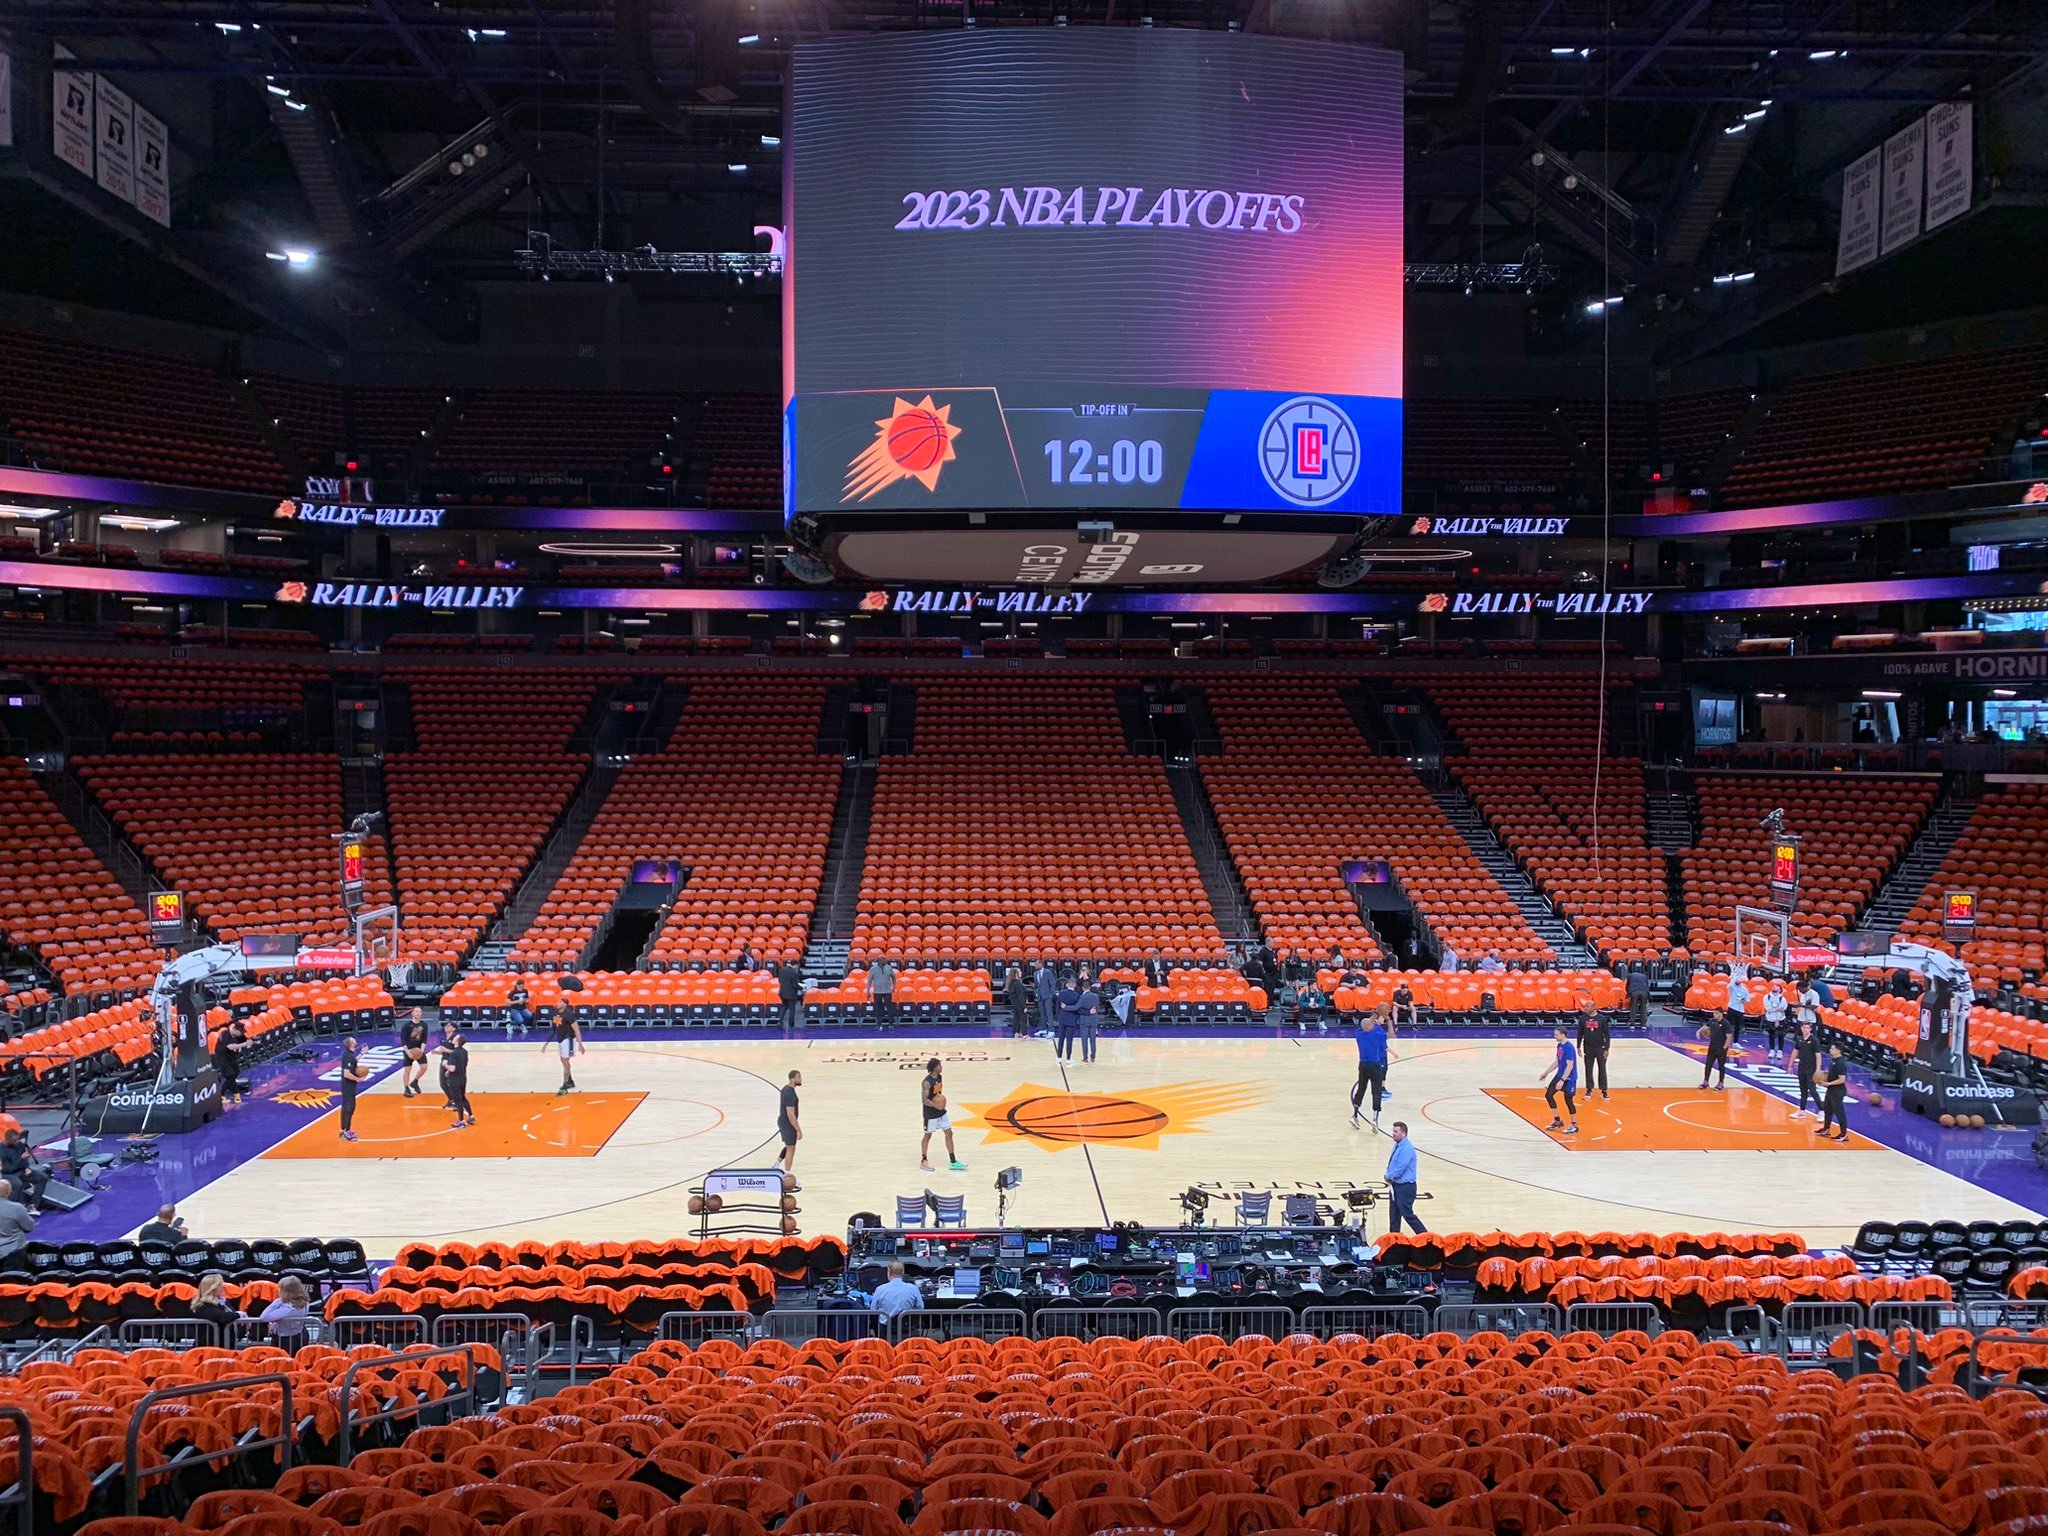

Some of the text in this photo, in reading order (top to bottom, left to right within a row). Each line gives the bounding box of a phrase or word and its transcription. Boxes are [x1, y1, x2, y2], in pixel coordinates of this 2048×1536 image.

[1937, 116, 1961, 142] SUNS
[1887, 127, 1922, 161] PHOENIX
[1892, 147, 1914, 173] SUNS
[1846, 154, 1879, 185] PHOENIX
[1850, 174, 1871, 199] SUNS
[894, 186, 1305, 234] 2023 NBA PLAYOFFS
[1080, 404, 1128, 415] TIP-OFF IN
[1044, 439, 1163, 485] 12:00
[1463, 484, 1491, 493] ASSIST
[297, 502, 447, 527] RALLY THE VALLEY
[1431, 518, 1494, 534] RALLY
[1501, 518, 1570, 534] VALLEY
[311, 583, 524, 608] RALLY THE VALLEY
[893, 591, 1092, 612] RALLY THE VALLEY
[1452, 593, 1653, 613] RALLY THE VALLEY
[1884, 662, 1949, 675] 100% AGAVE
[1701, 727, 1731, 740] HORNITOS
[1777, 846, 1795, 860] 12:00
[345, 859, 359, 881] 24
[1777, 859, 1792, 879] 24
[157, 895, 179, 906] 12:00
[1951, 895, 1972, 905] 12:00
[158, 906, 175, 918] 24
[1953, 905, 1968, 916] 24
[110, 1091, 184, 1107] coinbase
[1946, 1084, 2015, 1099] coinbase
[738, 1178, 765, 1186] Wilson
[1196, 1181, 1388, 1190] CENTER
[106, 1250, 134, 1263] PLAYOFFS
[179, 1250, 208, 1264] PLAYOFFS
[295, 1248, 321, 1262] PLAYOFFS
[332, 1250, 357, 1262] PLAYOFFS
